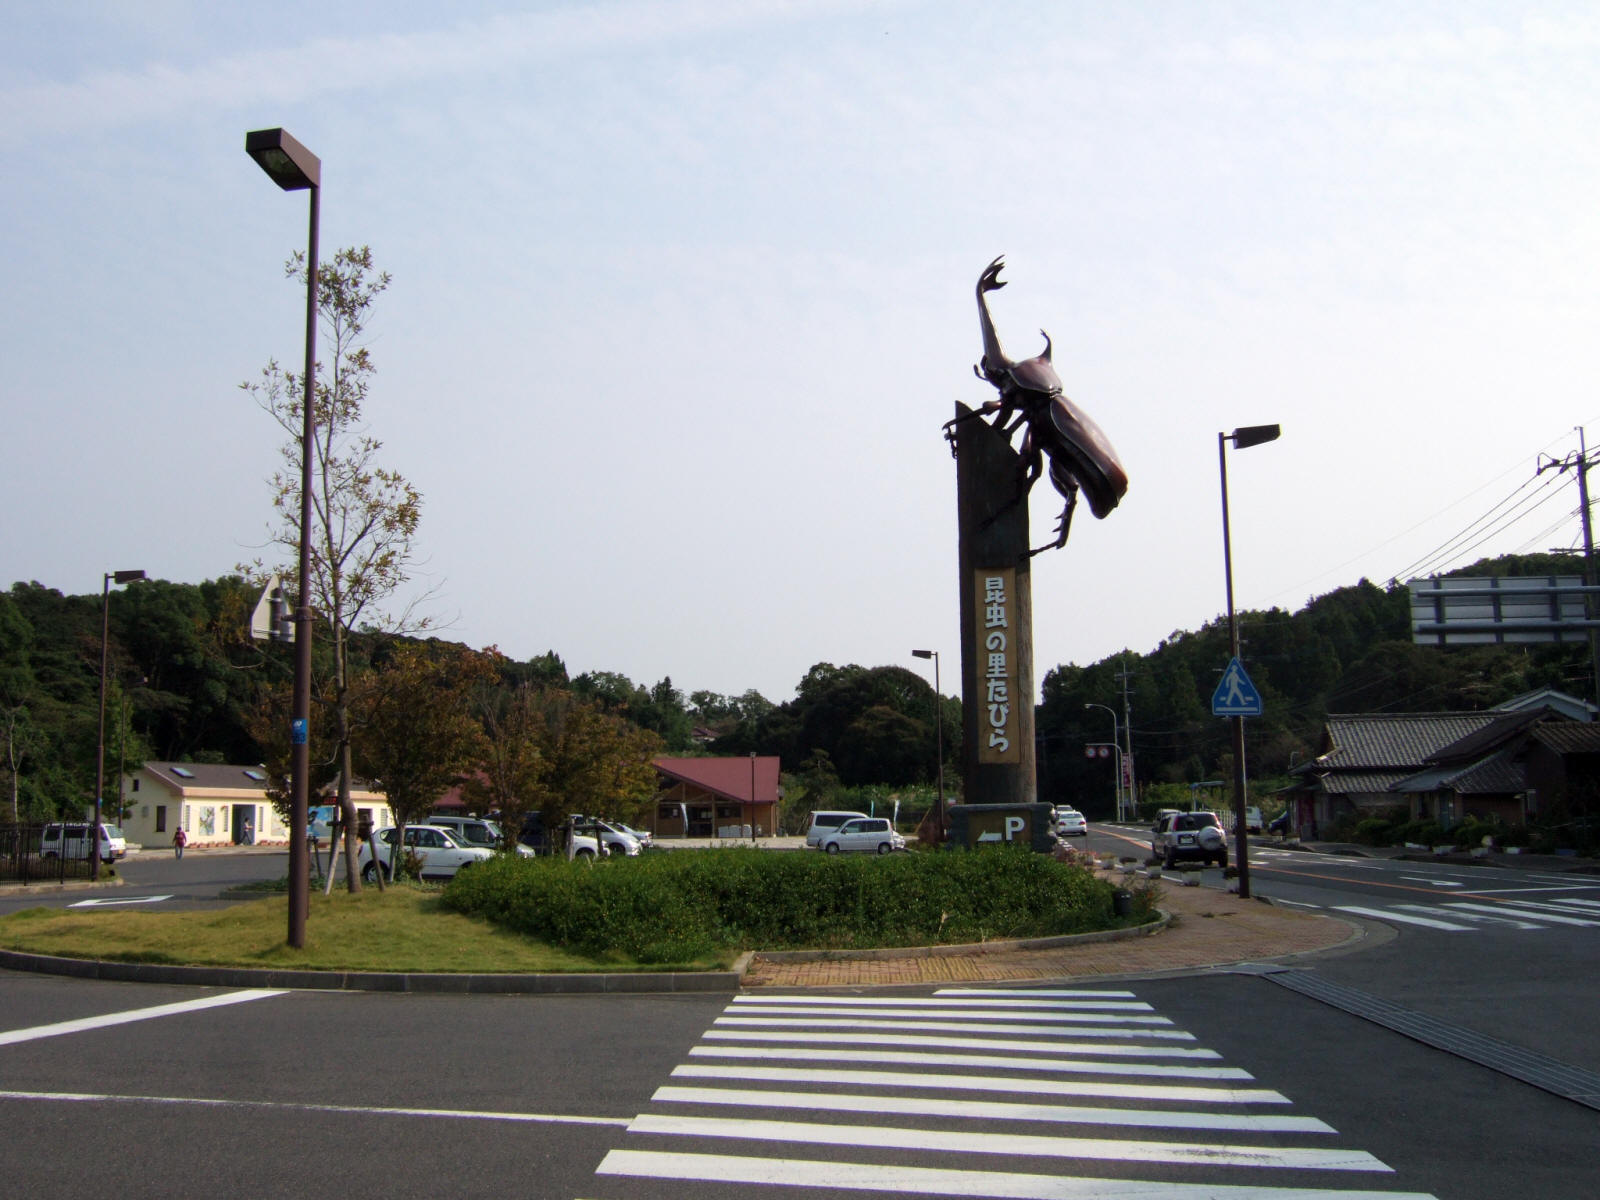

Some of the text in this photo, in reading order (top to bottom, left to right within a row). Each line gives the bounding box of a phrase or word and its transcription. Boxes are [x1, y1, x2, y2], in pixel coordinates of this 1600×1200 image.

[984, 577, 1009, 753] 昆虫の里たびら
[1005, 816, 1025, 841] P
